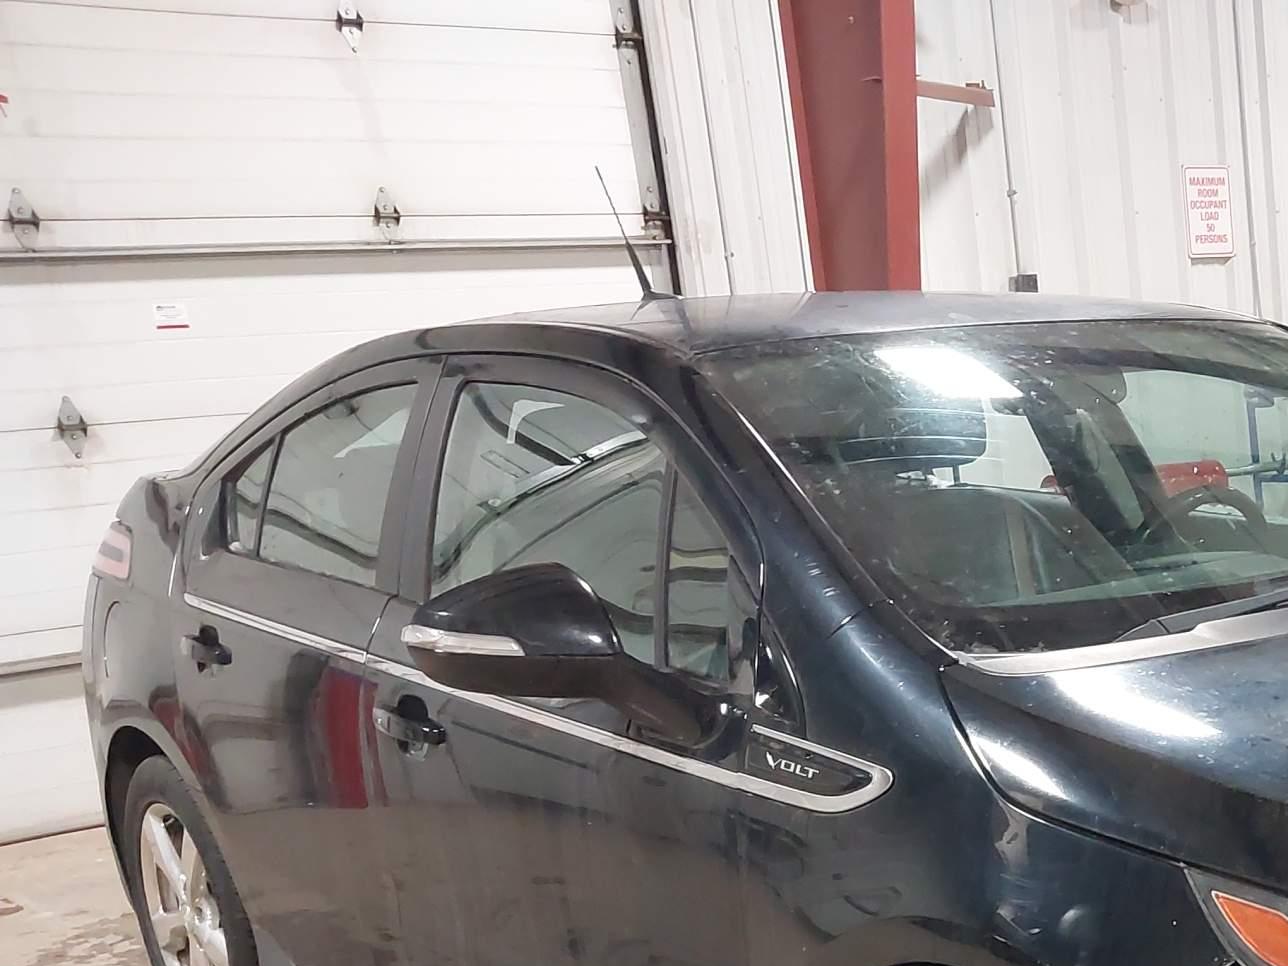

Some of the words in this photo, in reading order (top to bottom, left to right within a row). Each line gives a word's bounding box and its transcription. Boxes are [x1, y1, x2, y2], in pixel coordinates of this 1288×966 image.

[1189, 176, 1226, 186] MAXIMUM
[1197, 188, 1219, 198] ROOM
[1190, 200, 1227, 209] OCCUPANT
[1200, 211, 1219, 221] LOAD
[1206, 223, 1215, 232] 50
[1195, 234, 1228, 244] PERSONS
[766, 751, 820, 779] VOLT
